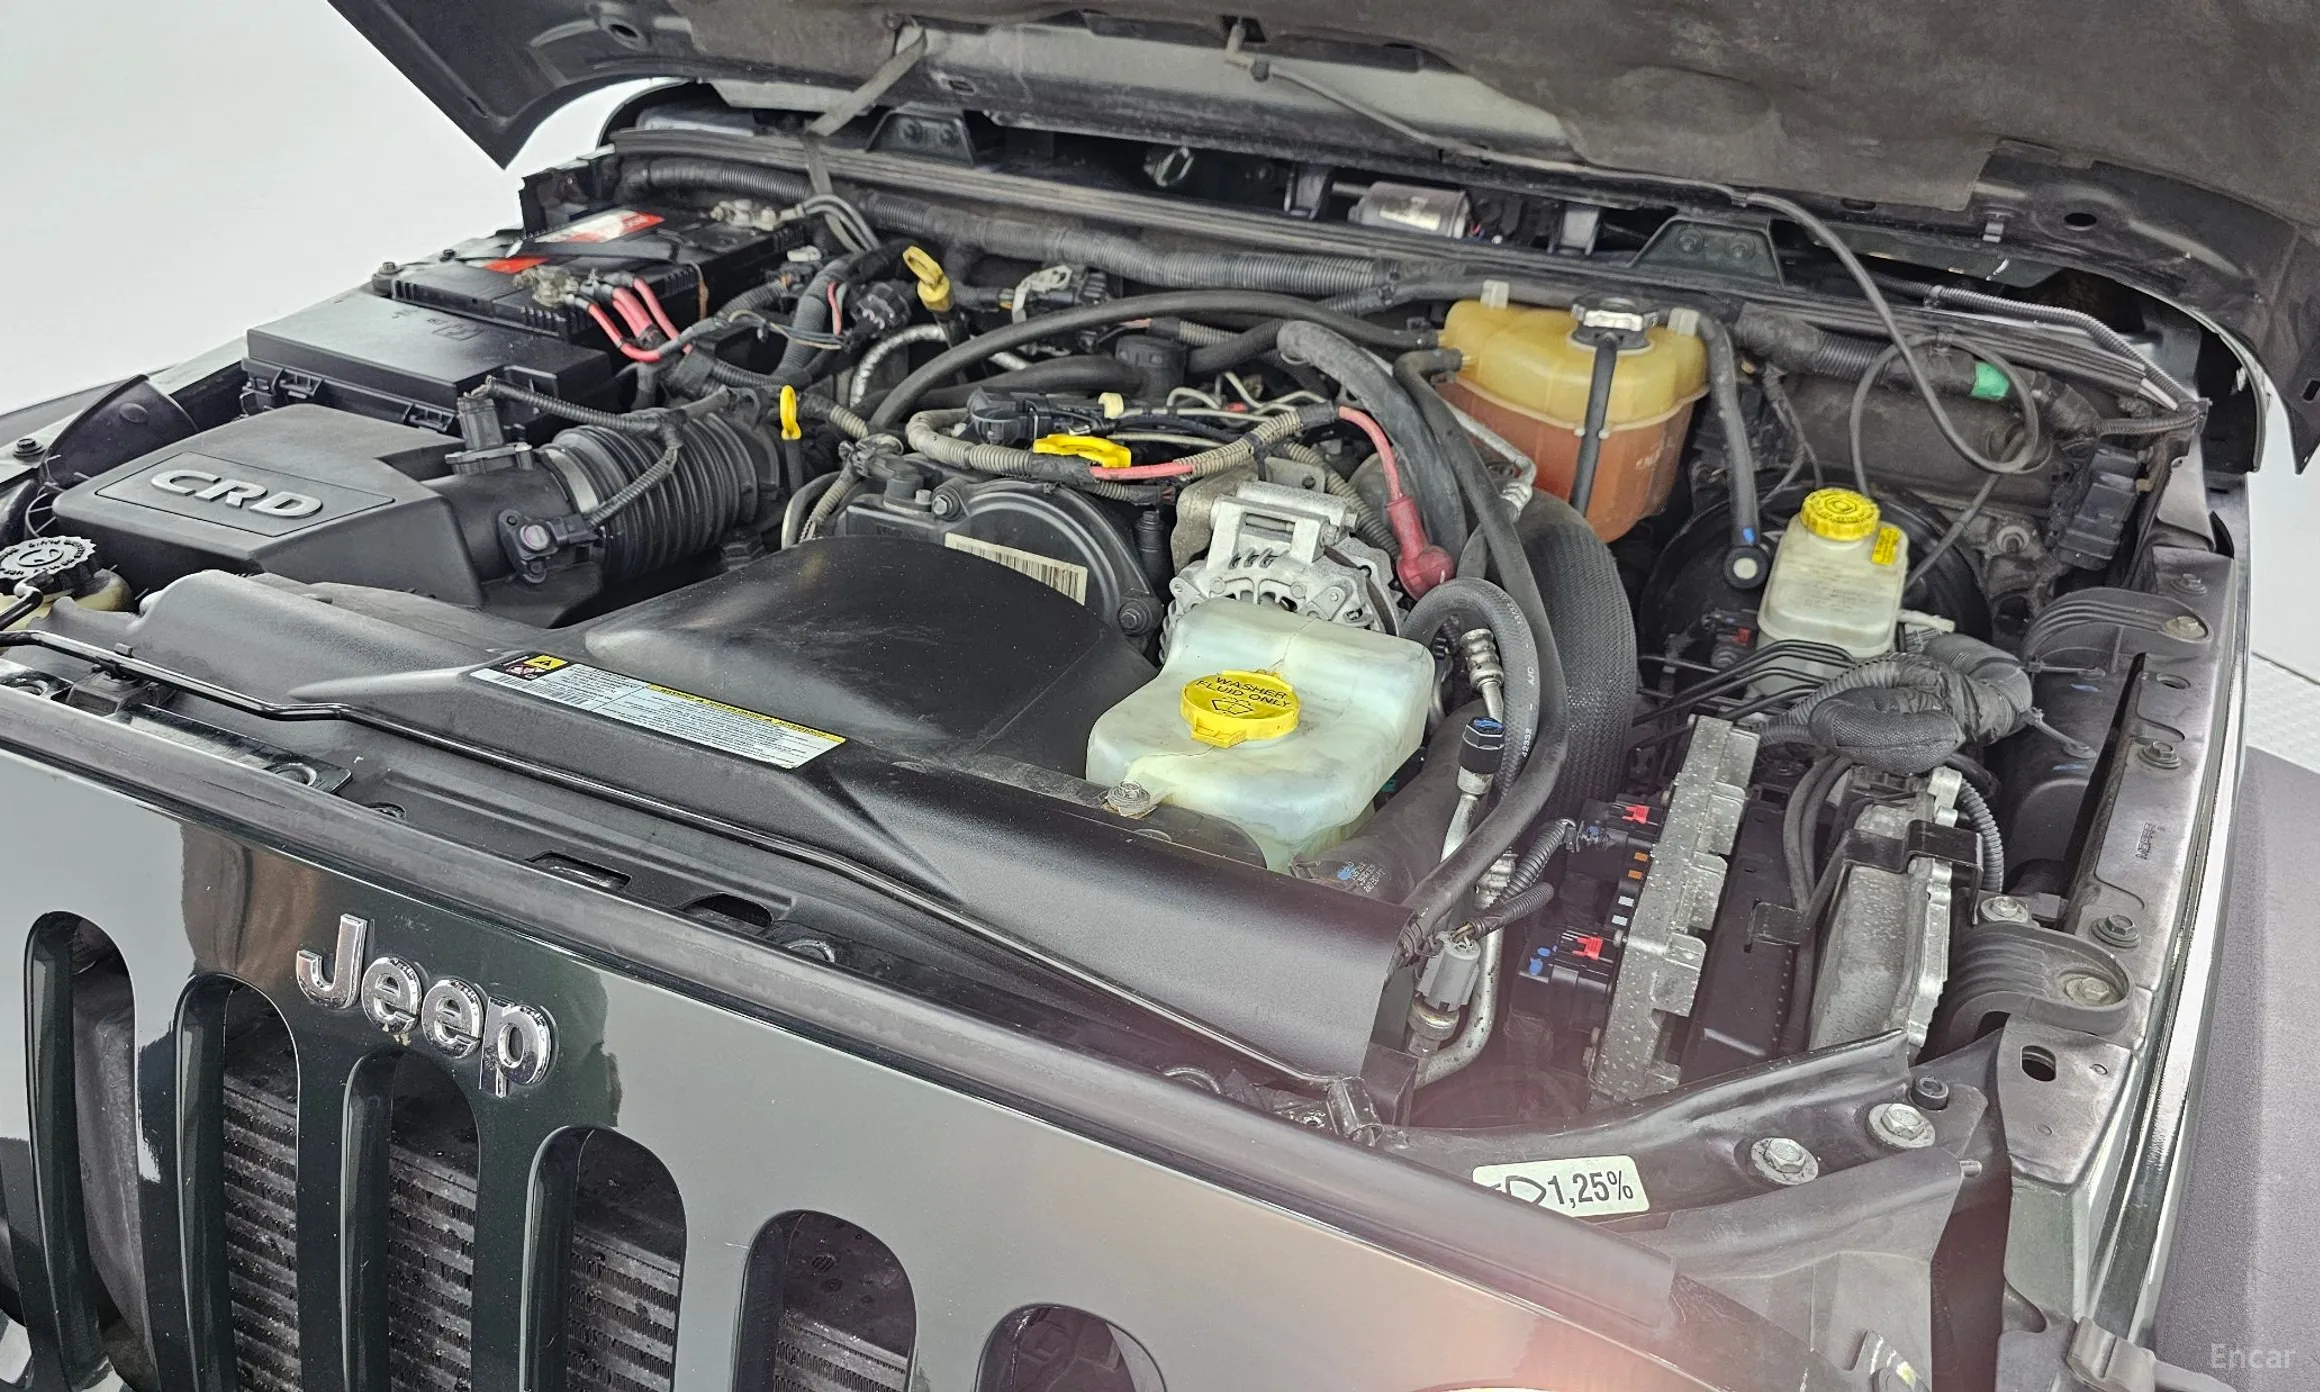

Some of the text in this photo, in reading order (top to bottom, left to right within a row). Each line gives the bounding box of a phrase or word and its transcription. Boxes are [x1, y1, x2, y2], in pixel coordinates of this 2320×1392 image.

[151, 469, 324, 520] CRD
[1216, 676, 1287, 700] WASHER
[1527, 666, 1535, 686] A/C
[1196, 680, 1292, 708] FLUID ONLY
[296, 913, 555, 1098] Jeep
[1547, 1169, 1634, 1209] 1,25%
